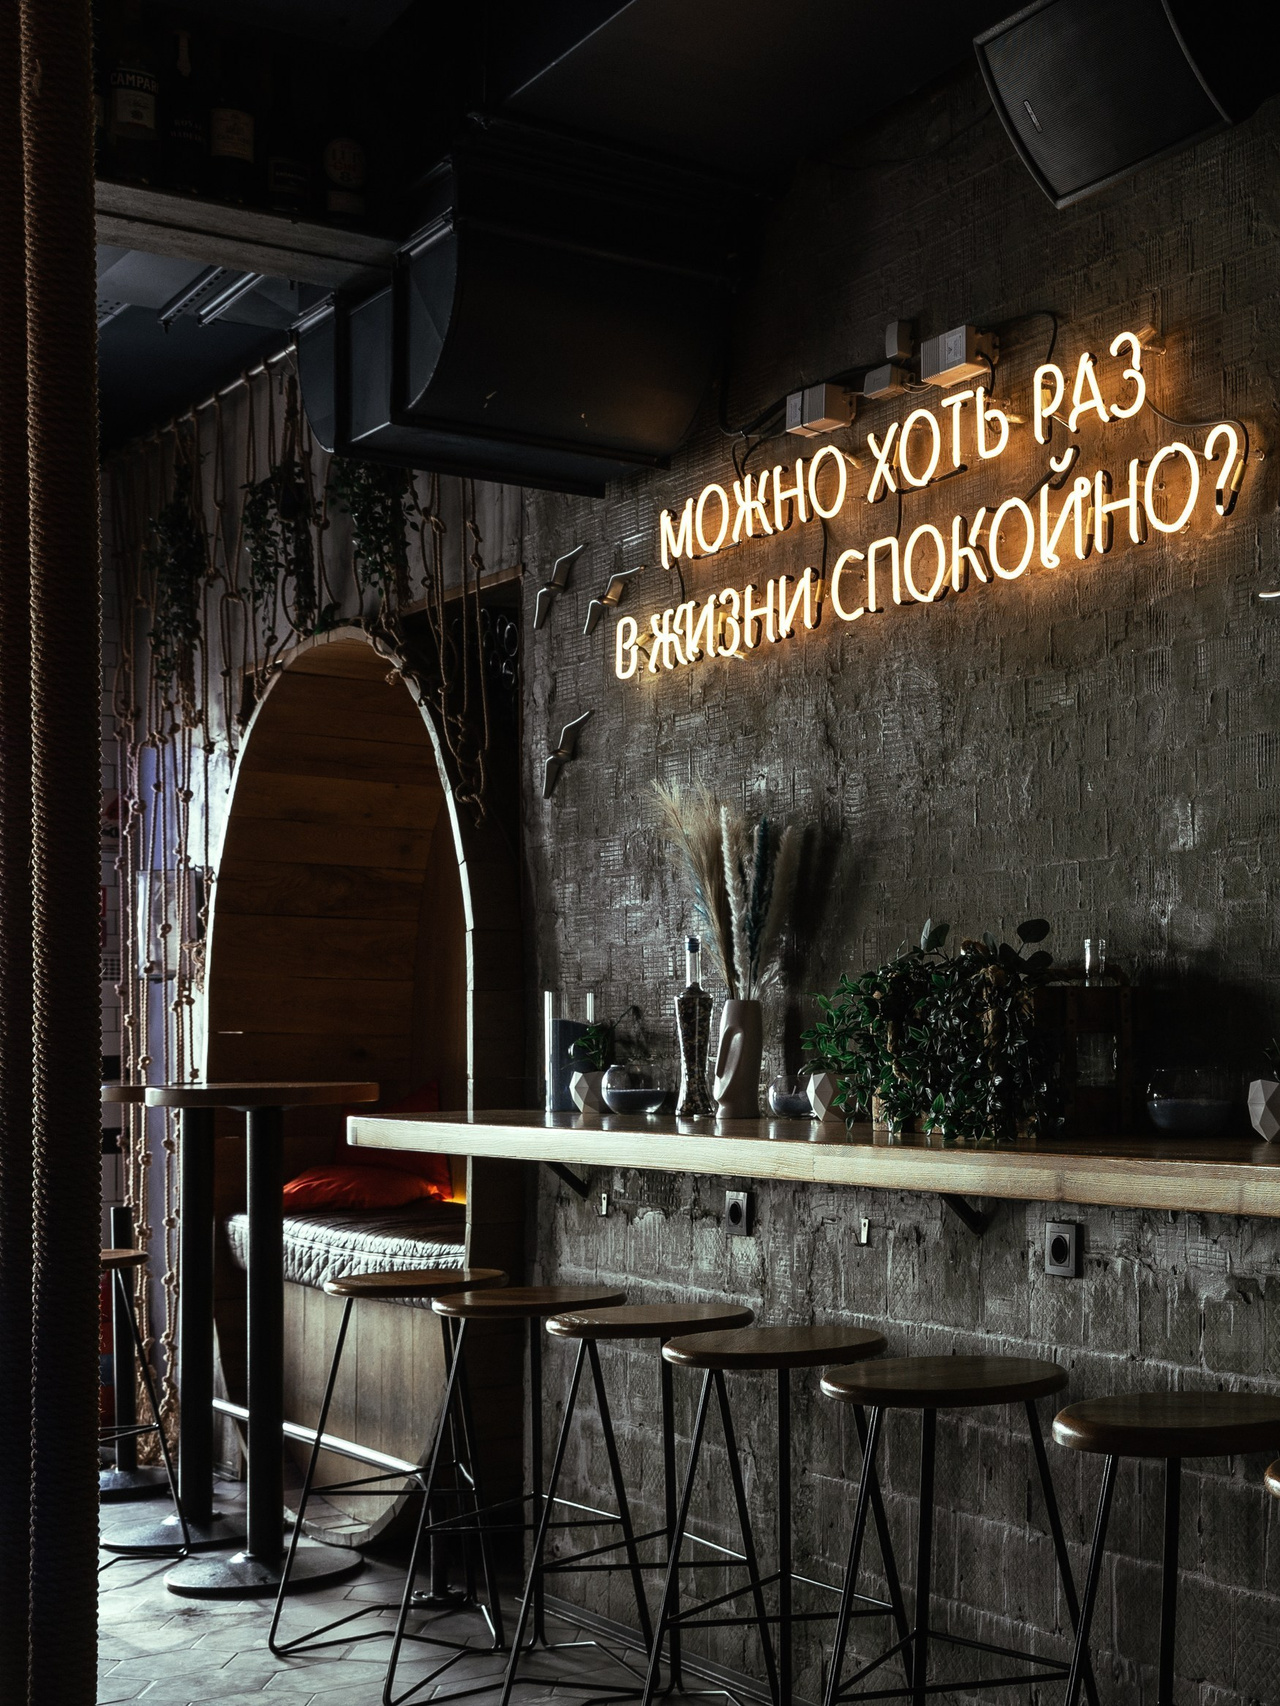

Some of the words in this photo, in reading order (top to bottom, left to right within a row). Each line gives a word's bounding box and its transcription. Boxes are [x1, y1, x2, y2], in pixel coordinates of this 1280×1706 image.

[615, 615, 638, 680] В
[647, 566, 814, 675] ЖИЗНИ
[831, 423, 1239, 622] СПОКОЙНО?
[660, 445, 848, 571] МОЖНО
[867, 385, 1009, 503] ХОТЬ
[1033, 331, 1147, 445] РАЗ
